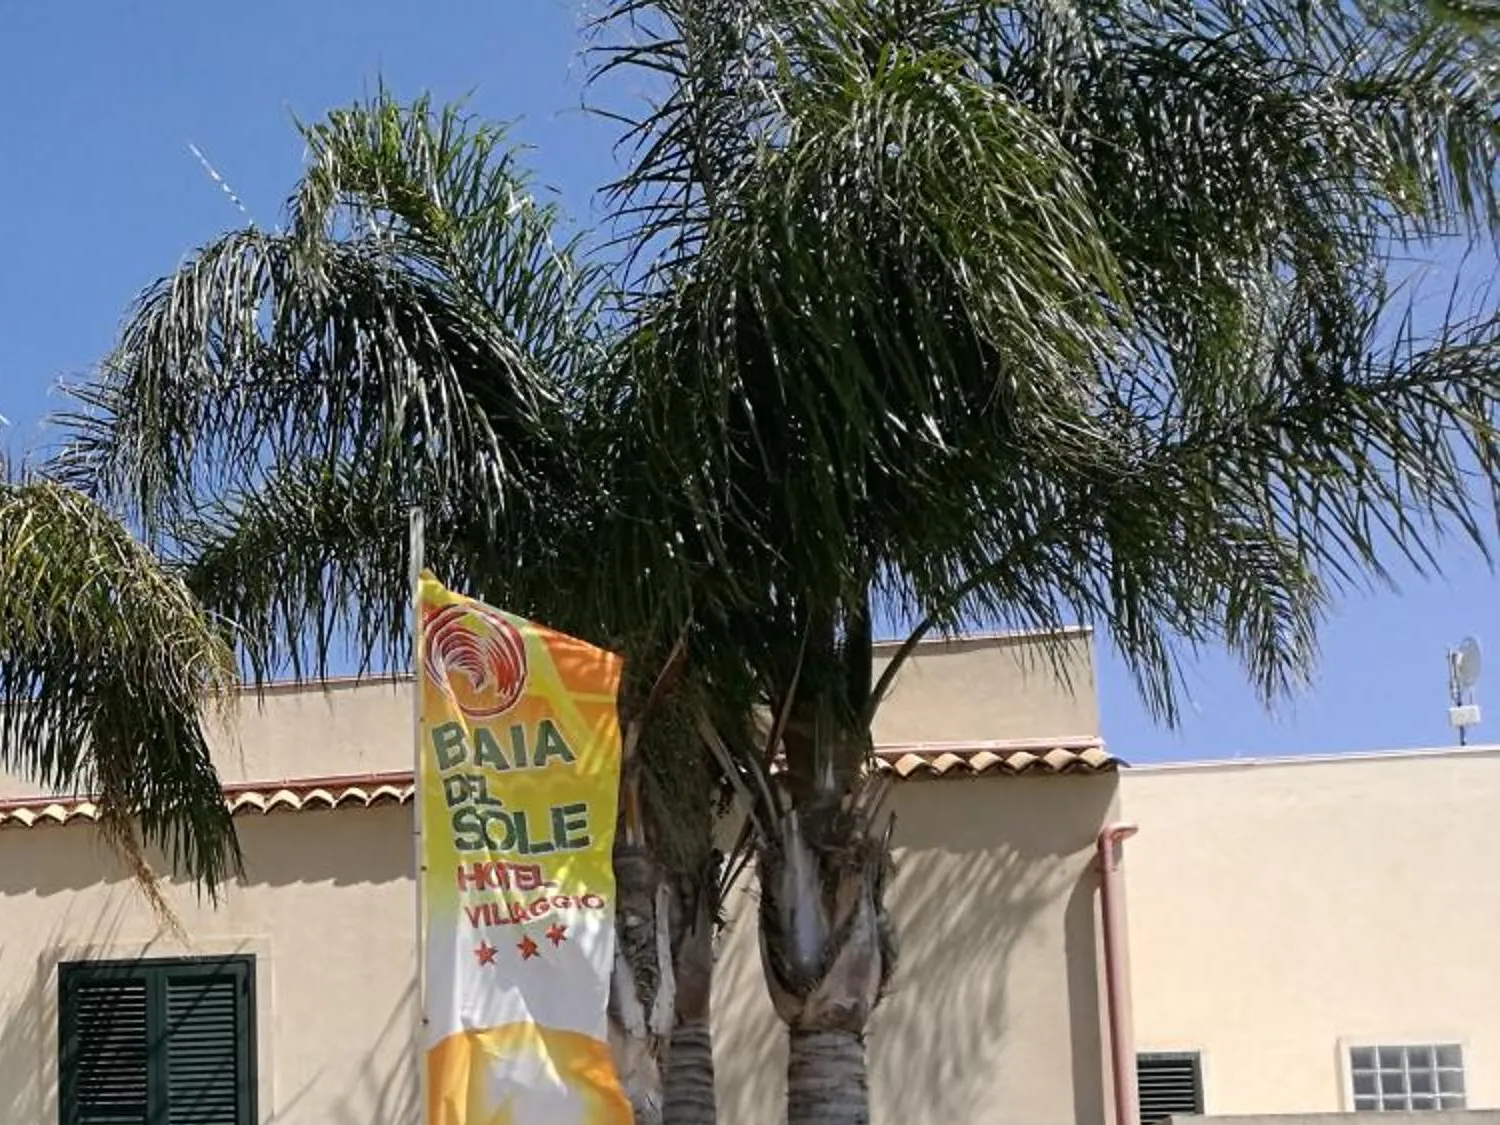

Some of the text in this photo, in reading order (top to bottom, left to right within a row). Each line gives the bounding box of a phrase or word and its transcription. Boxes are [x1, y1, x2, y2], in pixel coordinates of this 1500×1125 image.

[432, 719, 577, 771] BAIA
[443, 773, 503, 807] DEL
[452, 803, 591, 854] SOLE
